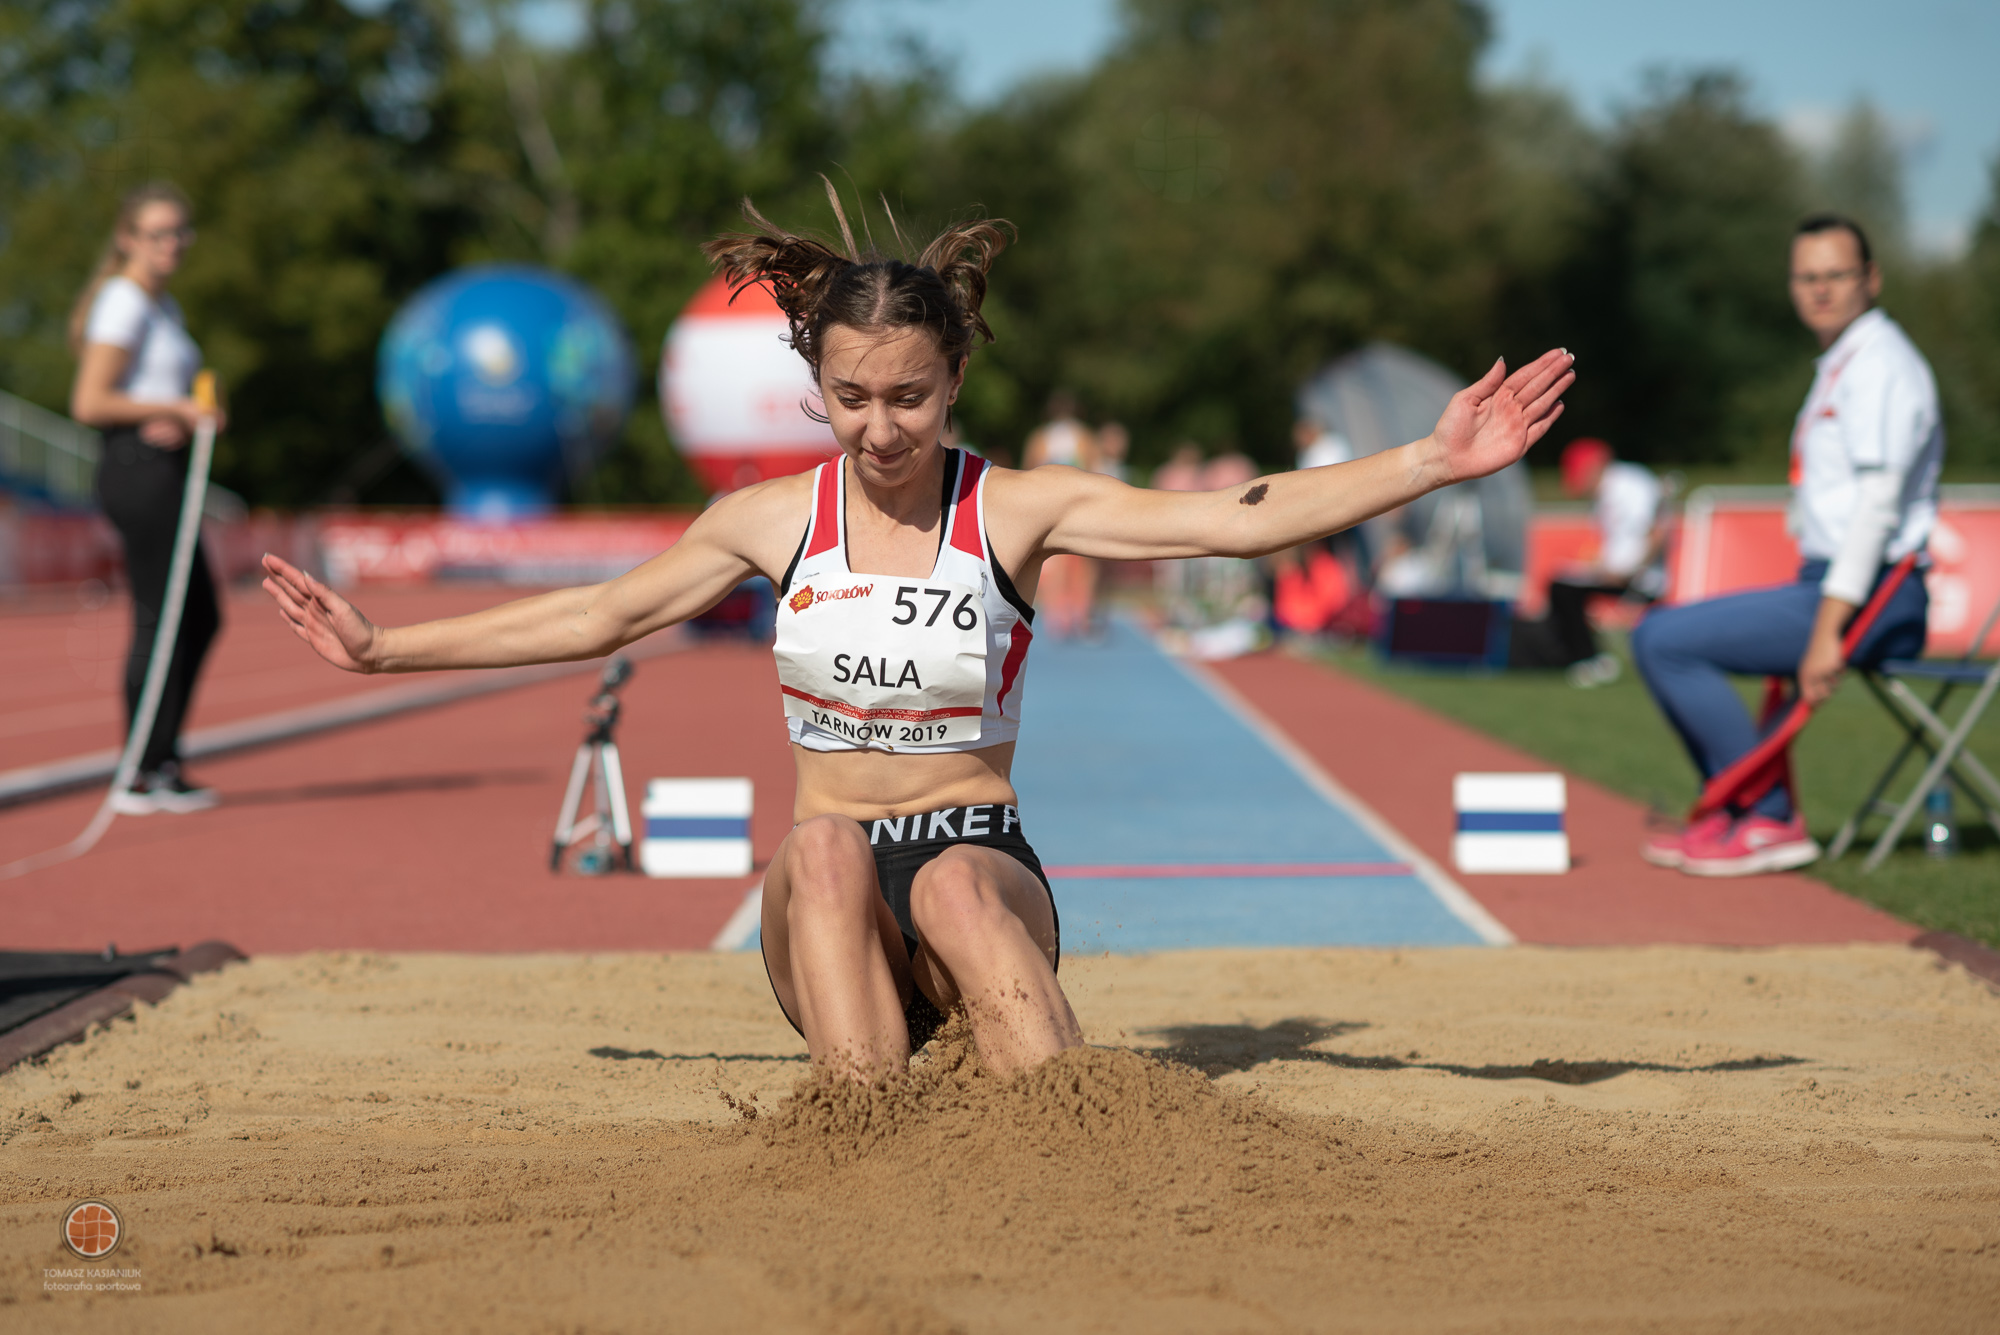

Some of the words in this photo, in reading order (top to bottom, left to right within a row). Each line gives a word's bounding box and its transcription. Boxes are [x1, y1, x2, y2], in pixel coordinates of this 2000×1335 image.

[891, 586, 978, 631] 576
[833, 653, 922, 690] SALA
[811, 709, 893, 741] TARNÓW
[899, 723, 948, 742] 2019
[870, 804, 994, 845] NIKE
